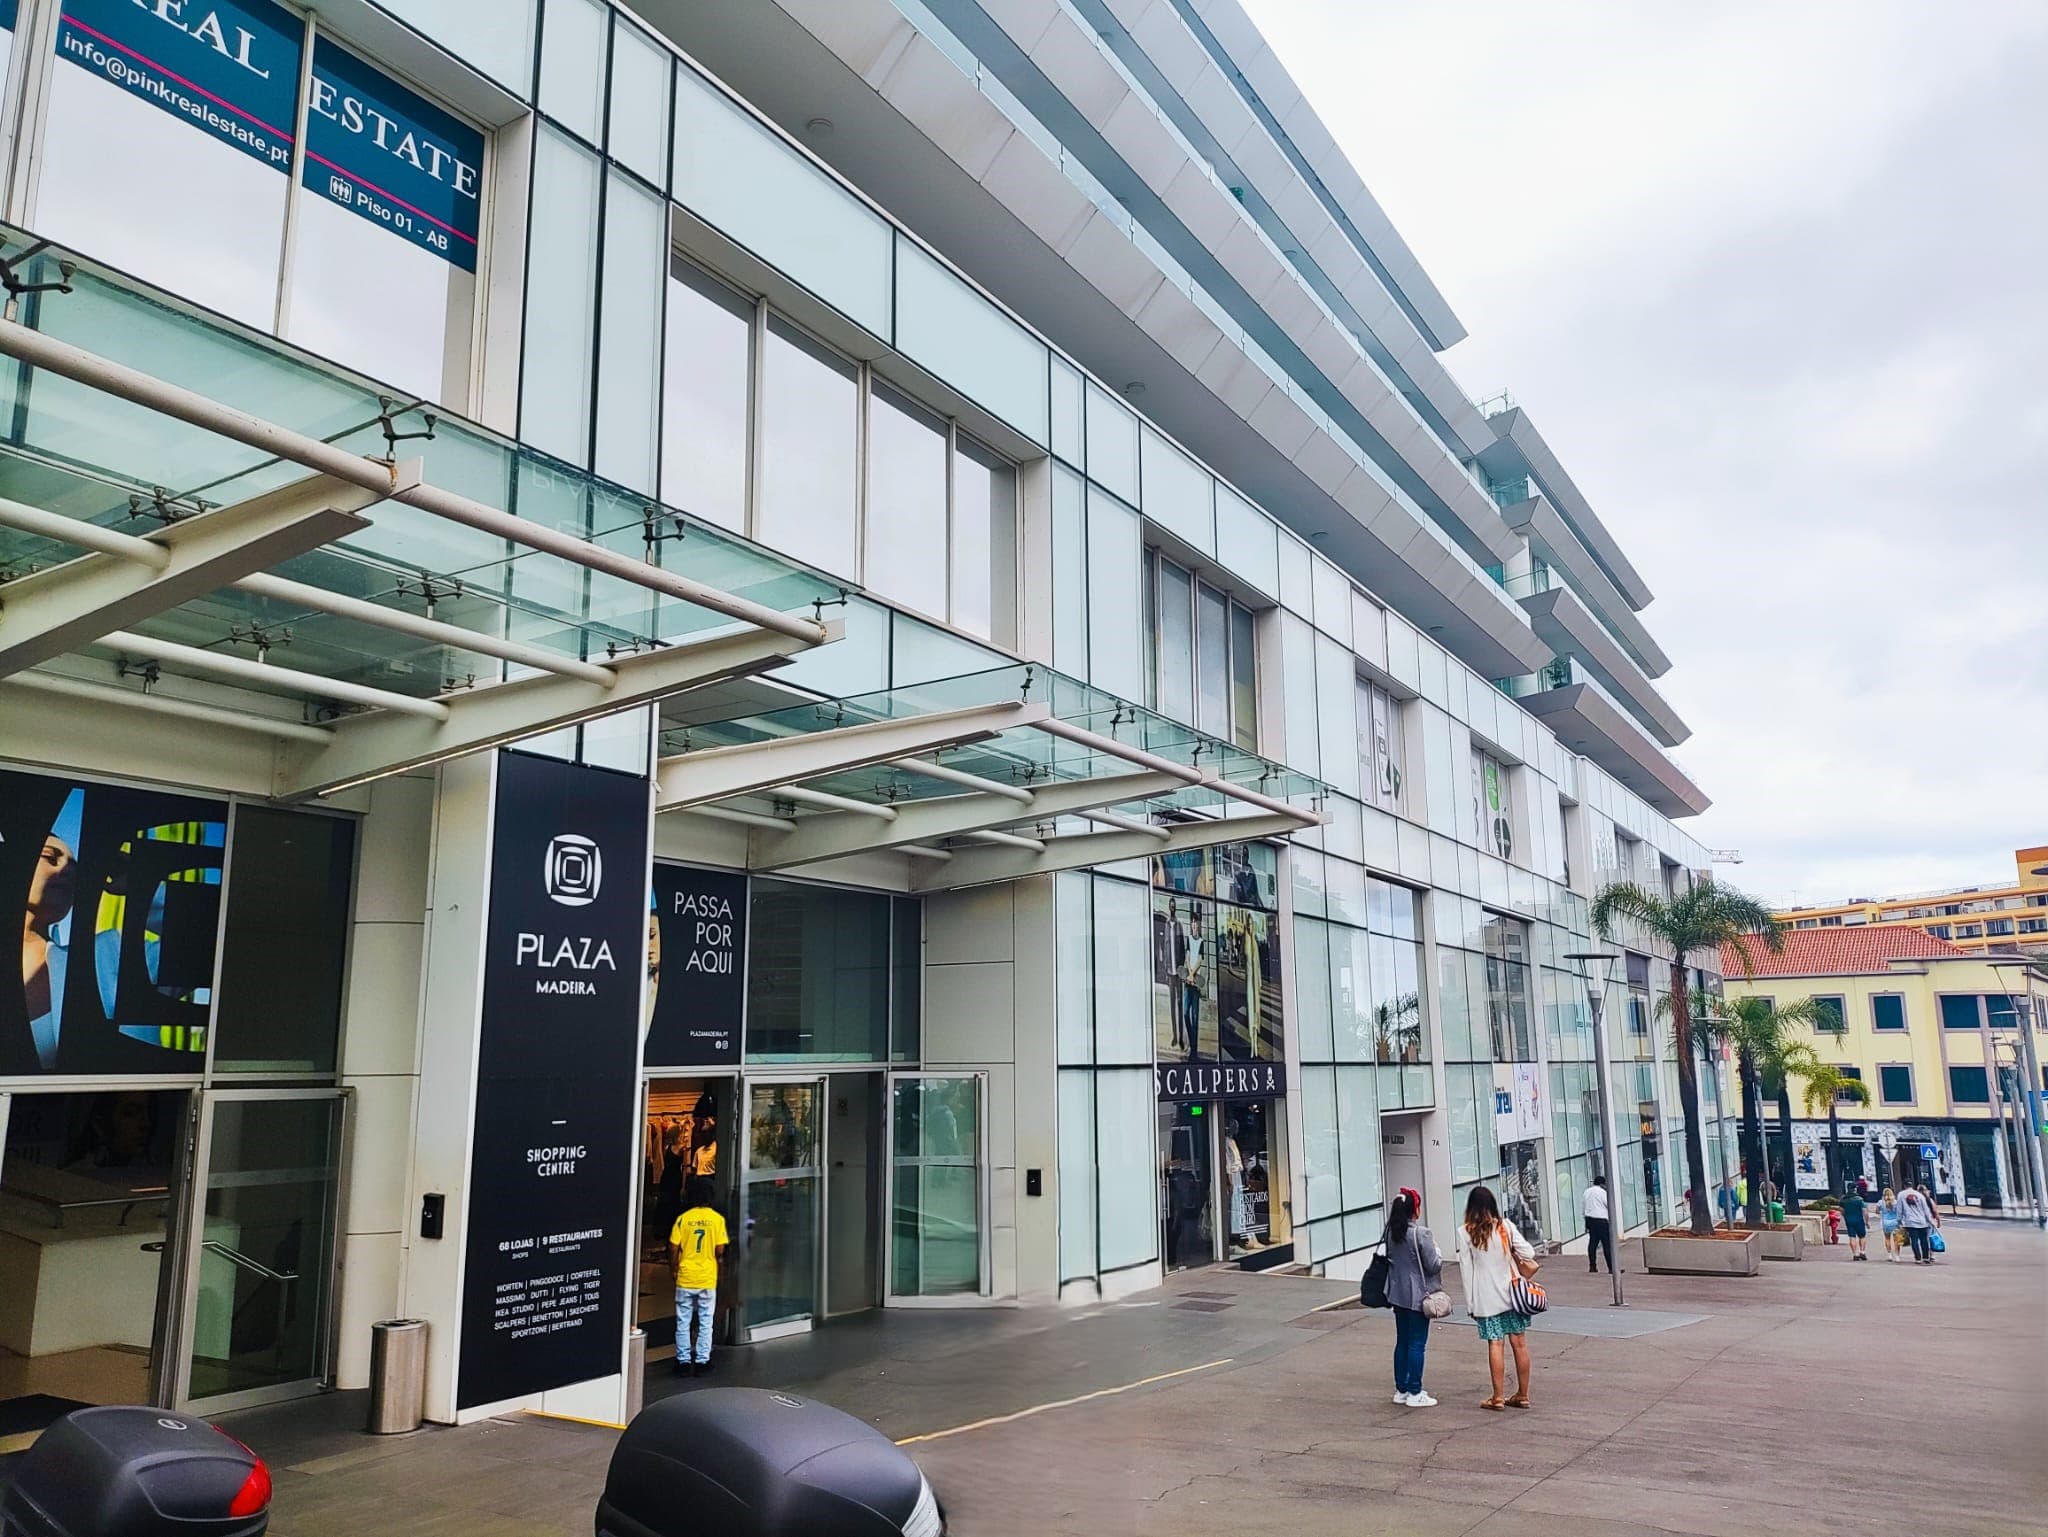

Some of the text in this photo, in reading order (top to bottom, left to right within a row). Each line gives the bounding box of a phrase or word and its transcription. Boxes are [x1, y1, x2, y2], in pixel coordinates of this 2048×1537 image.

[131, 0, 270, 80] EAL
[63, 32, 290, 166] info@pinkrealestate.pt
[309, 74, 477, 200] ESTATE
[357, 191, 391, 222] Piso
[395, 212, 413, 233] 01
[426, 230, 448, 251] AB
[674, 891, 734, 920] PASSA
[695, 921, 733, 947] POR
[515, 932, 617, 971] PLAZA
[685, 950, 733, 975] AQUI
[535, 979, 597, 996] MADEIRA
[526, 1145, 588, 1163] SHOPPING
[537, 1160, 576, 1177] CENTRE
[510, 1238, 534, 1250] LOJAS
[542, 1236, 548, 1246] 9
[548, 1228, 603, 1245] RESTAURANTES
[693, 1229, 706, 1254] 7
[495, 1280, 601, 1305] MASSIMO DUTTI FLYING TIGER
[495, 1292, 600, 1318] IKEA STUDIO PEPE JEANS TOUS
[494, 1303, 600, 1331] SCALPERS BENETTON SKECHERS
[511, 1324, 548, 1340] SPORTZONE
